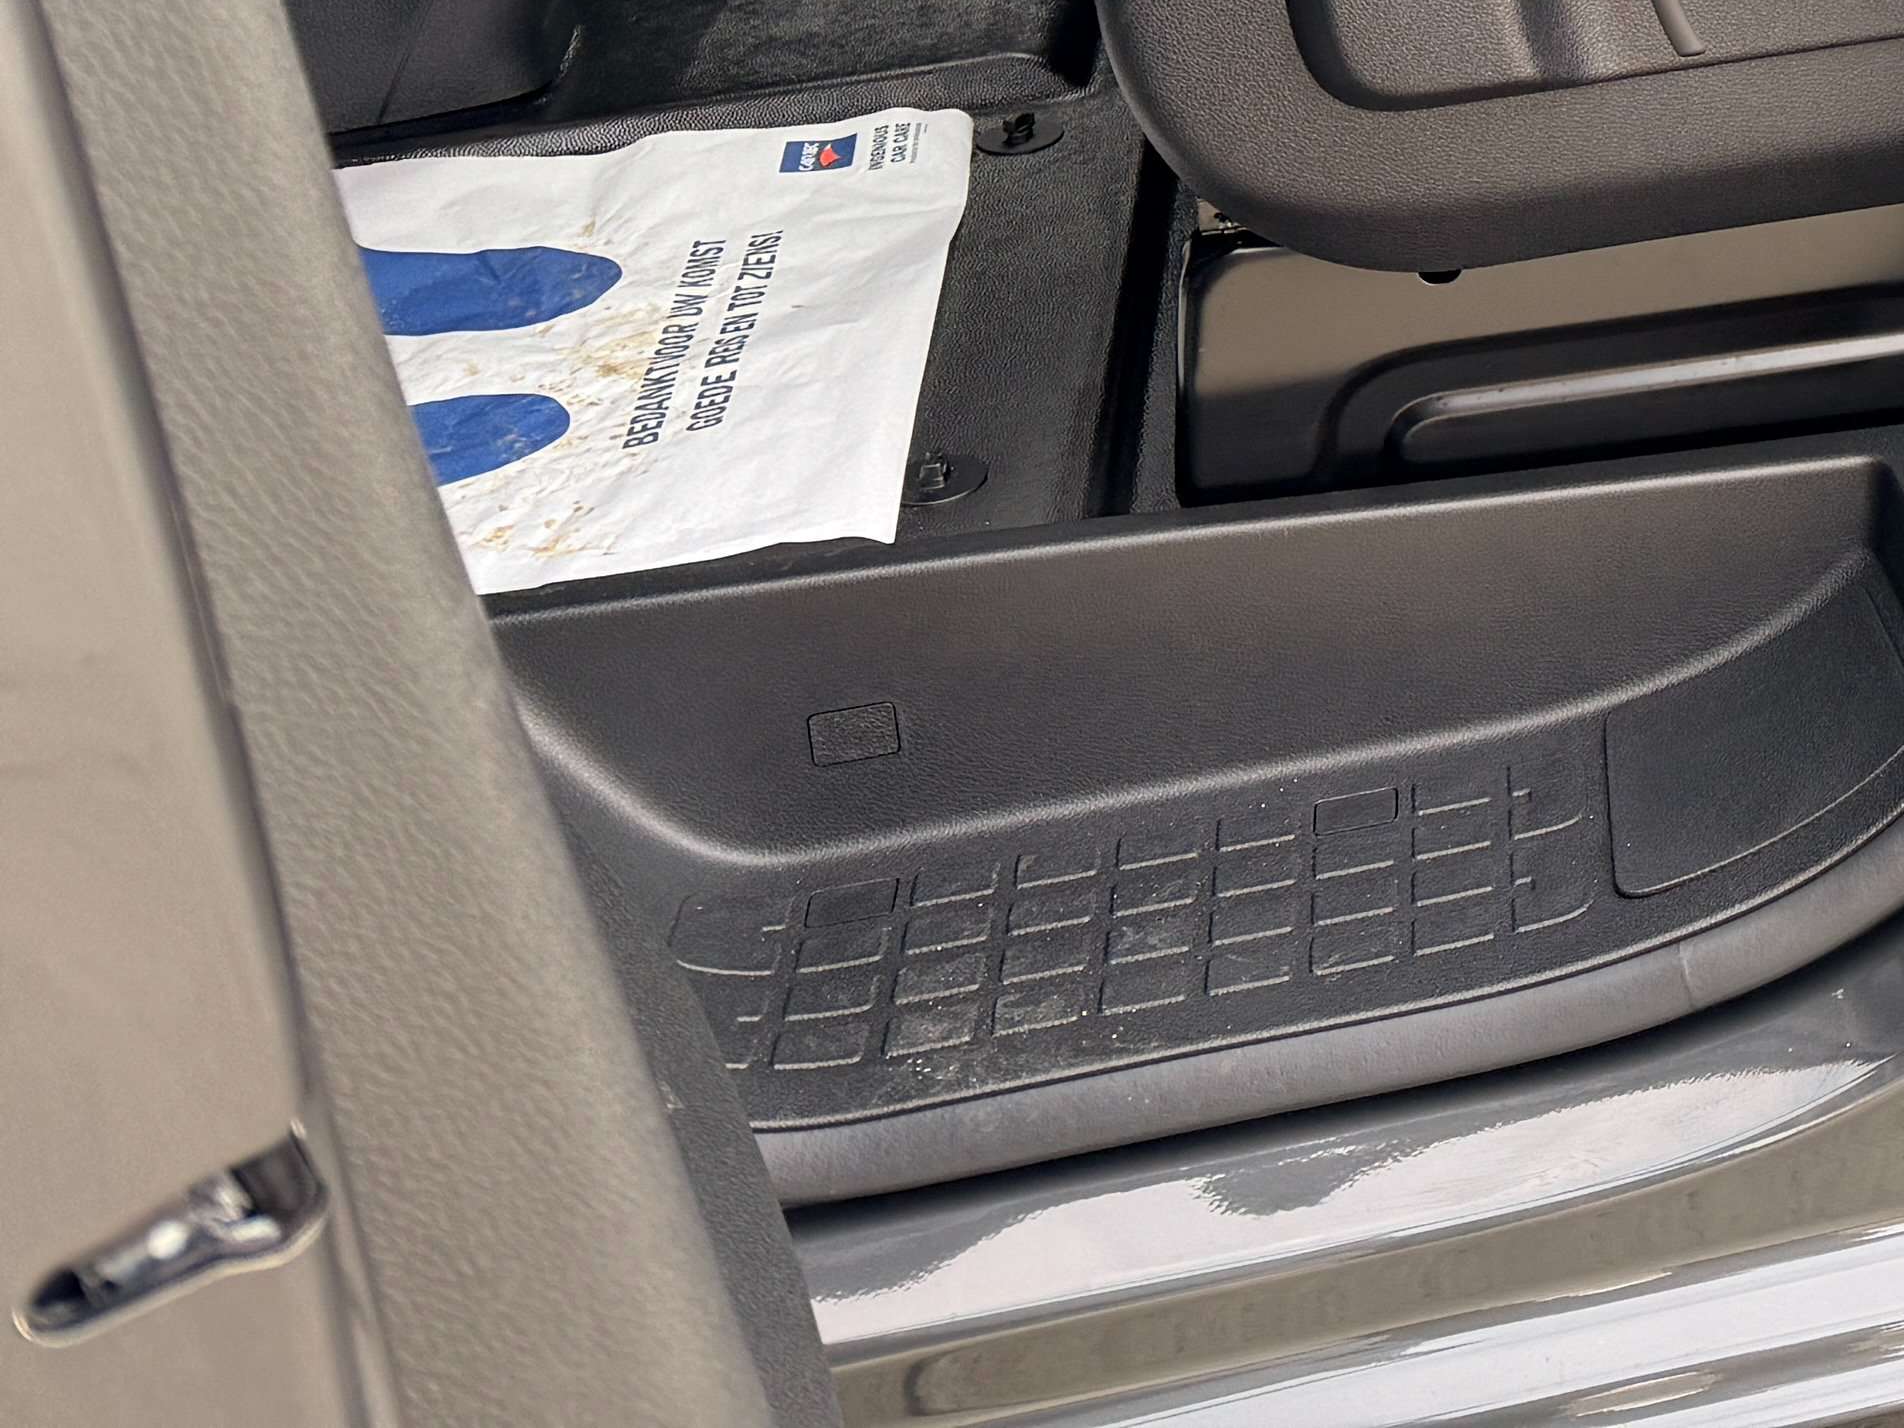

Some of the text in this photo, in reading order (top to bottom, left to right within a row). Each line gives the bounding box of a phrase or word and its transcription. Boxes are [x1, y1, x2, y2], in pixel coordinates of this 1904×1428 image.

[868, 124, 889, 171] INGENIOUS
[890, 122, 911, 164] CAR CARE
[737, 230, 784, 281] ZIENS!
[727, 284, 769, 312] TOT
[622, 239, 727, 449] BEDANKT VOOR UW KOMST
[719, 312, 760, 335] EN
[685, 369, 738, 432] GOEDE
